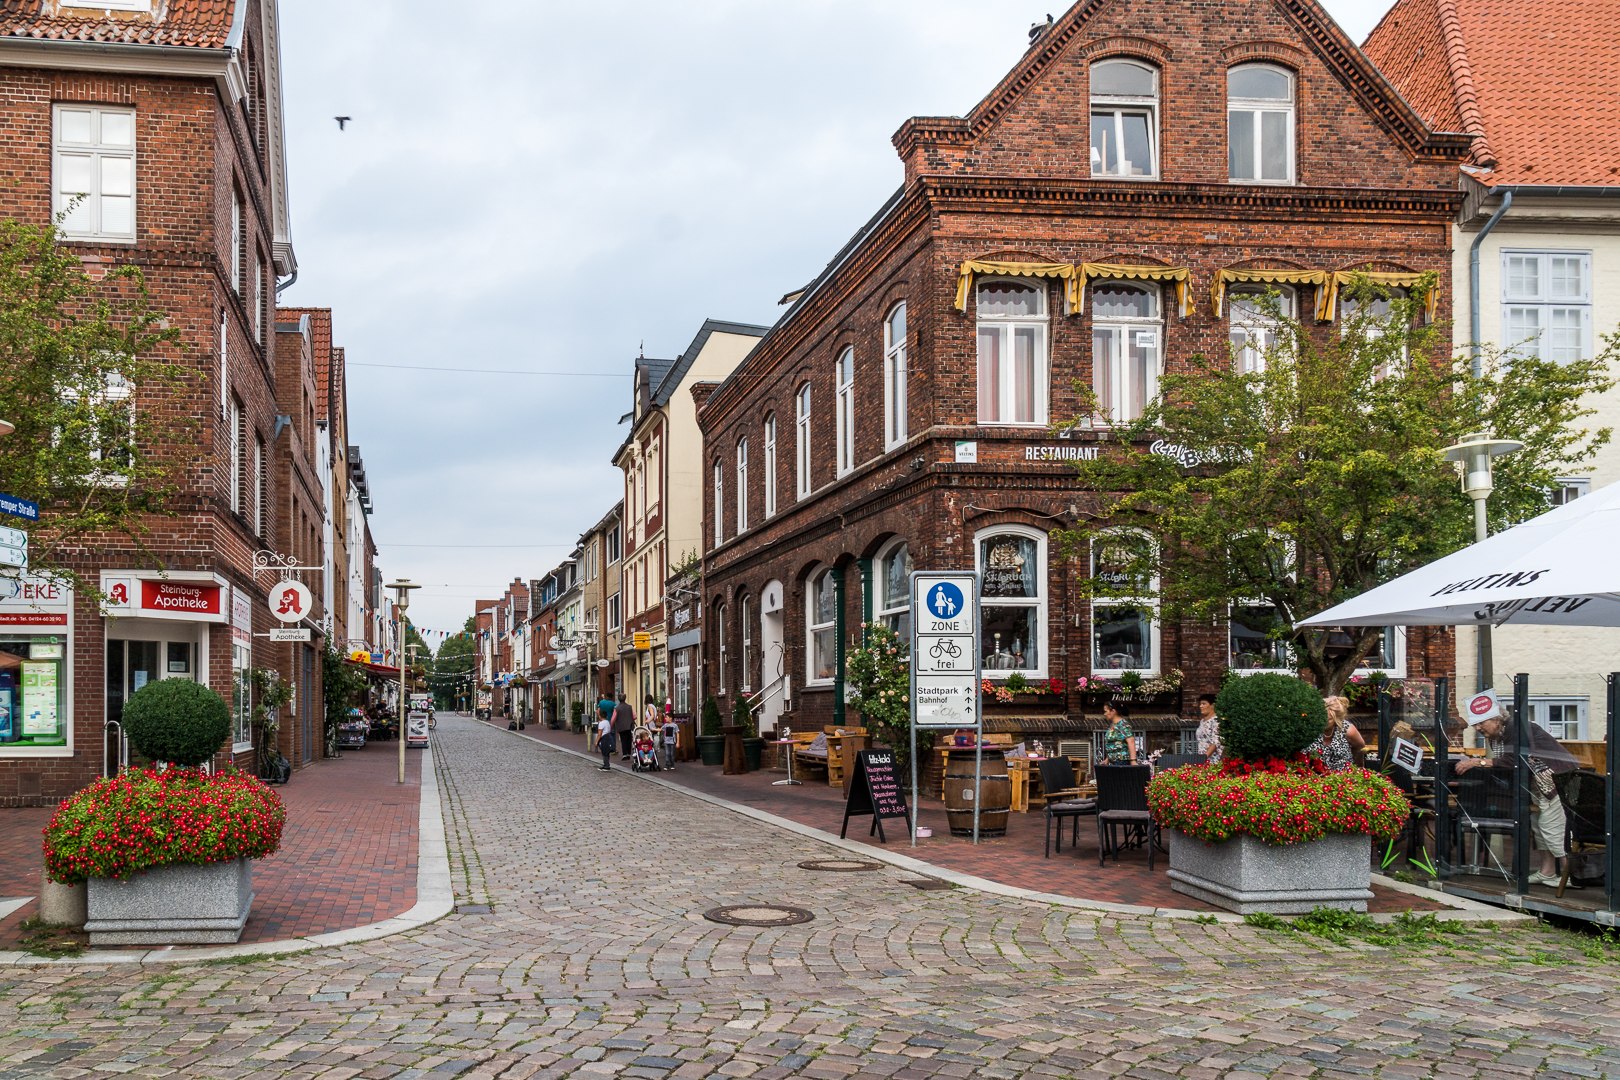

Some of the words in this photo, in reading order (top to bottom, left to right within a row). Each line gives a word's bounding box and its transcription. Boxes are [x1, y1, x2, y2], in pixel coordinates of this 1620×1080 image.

[1025, 446, 1100, 461] RESTAURANT
[18, 502, 36, 517] Straße
[1429, 569, 1551, 597] VELTINS
[160, 584, 202, 597] Steinburg-
[154, 594, 208, 609] Apotheke
[931, 621, 960, 631] ZONE
[937, 660, 955, 668] frei
[917, 687, 959, 695] Stadtpark
[1112, 693, 1133, 701] Hotel
